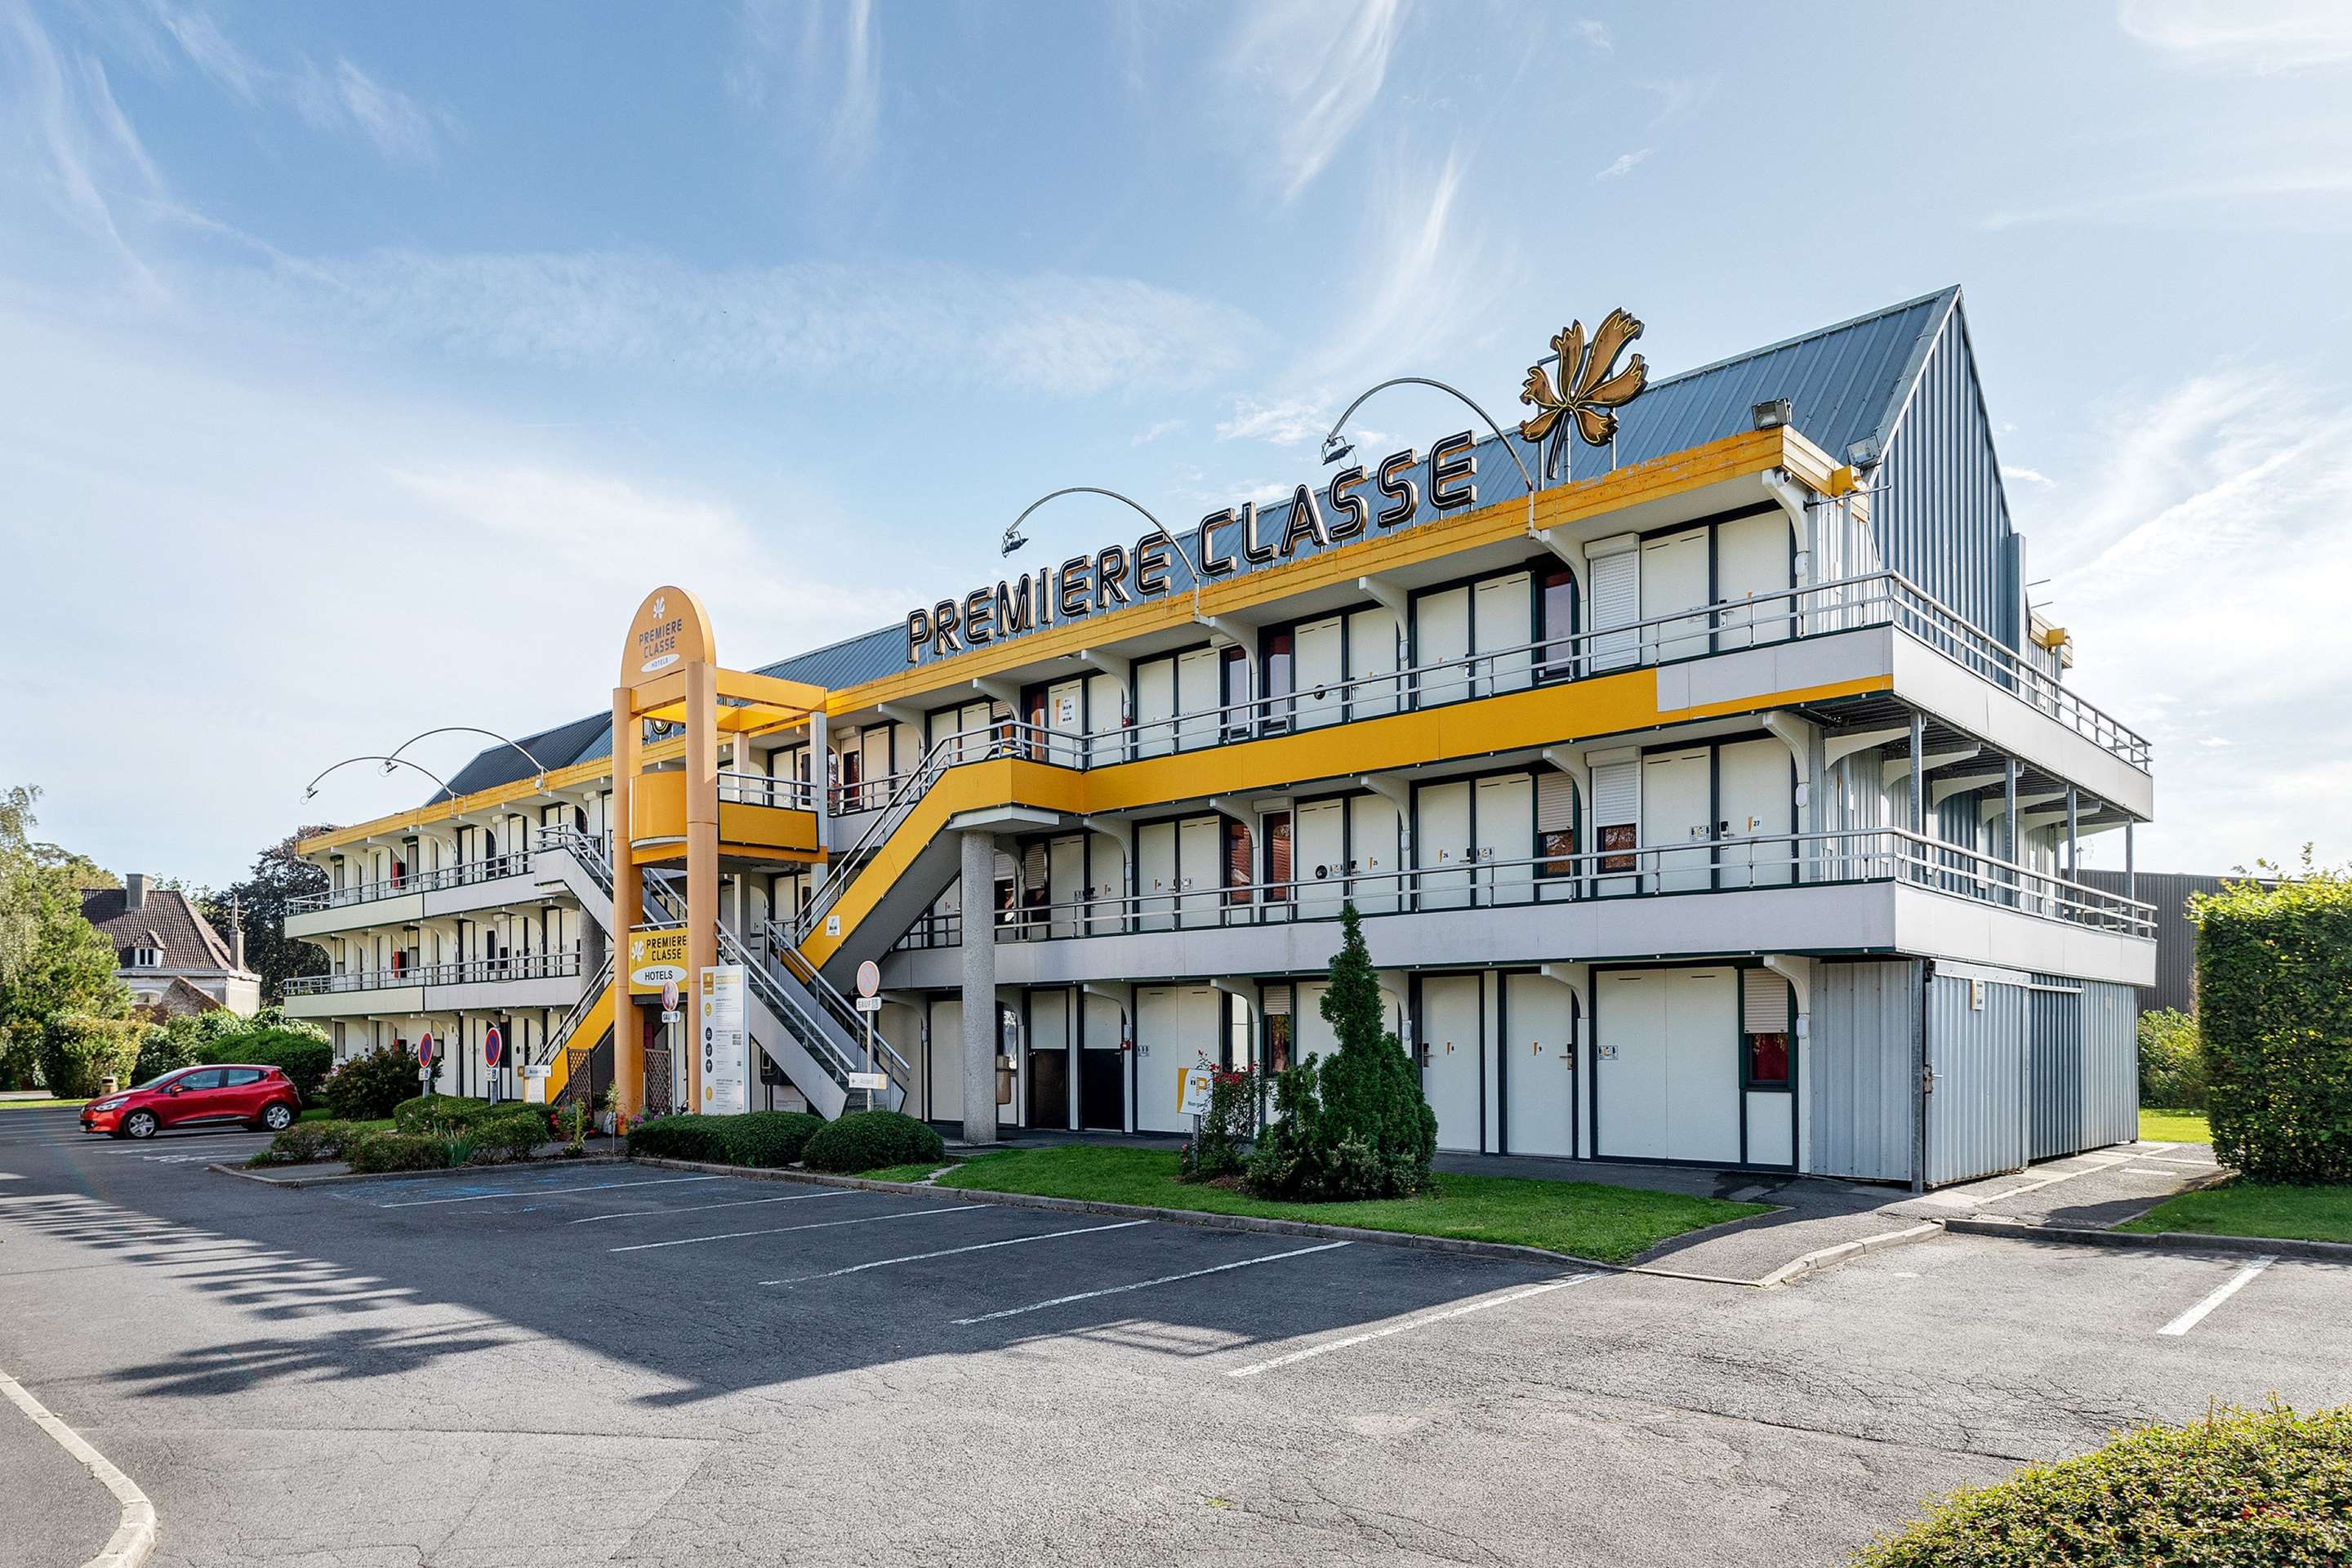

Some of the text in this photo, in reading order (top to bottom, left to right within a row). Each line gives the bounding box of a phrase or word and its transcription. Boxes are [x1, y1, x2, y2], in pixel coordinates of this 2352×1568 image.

[906, 430, 1478, 663] PREMIERE CLASSE
[639, 618, 683, 646] PREMIERE
[644, 635, 675, 659] CLASSE
[646, 936, 687, 949] PREMIERE
[652, 948, 681, 961] CLASSE
[644, 970, 673, 981] HOTELS
